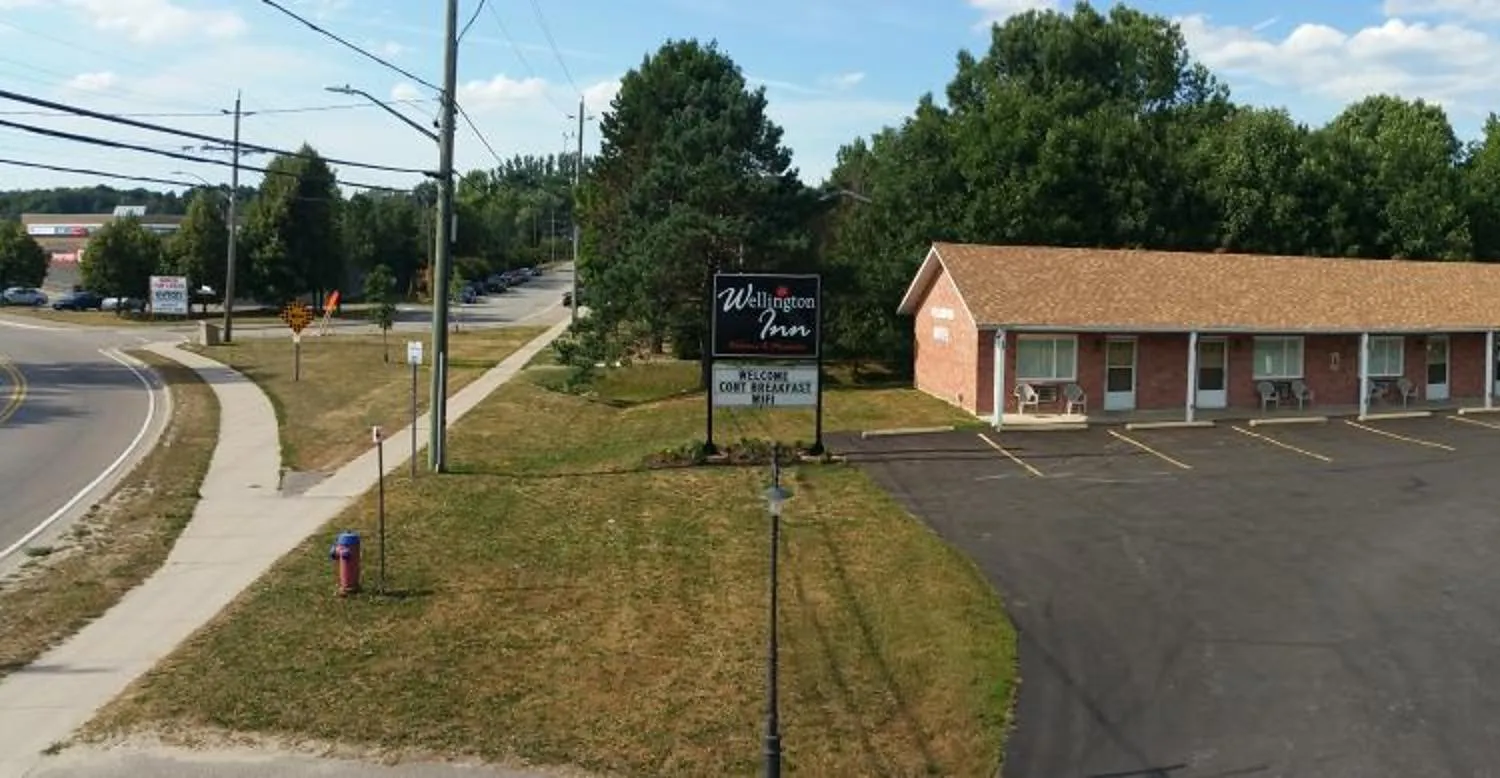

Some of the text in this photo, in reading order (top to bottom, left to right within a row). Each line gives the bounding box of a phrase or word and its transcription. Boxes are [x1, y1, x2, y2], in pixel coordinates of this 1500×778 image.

[717, 283, 816, 313] Wellington
[758, 307, 812, 340] Inn
[739, 370, 788, 381] WELCOME
[720, 382, 812, 393] CONT BREAKFAST
[752, 394, 776, 405] WIFI
